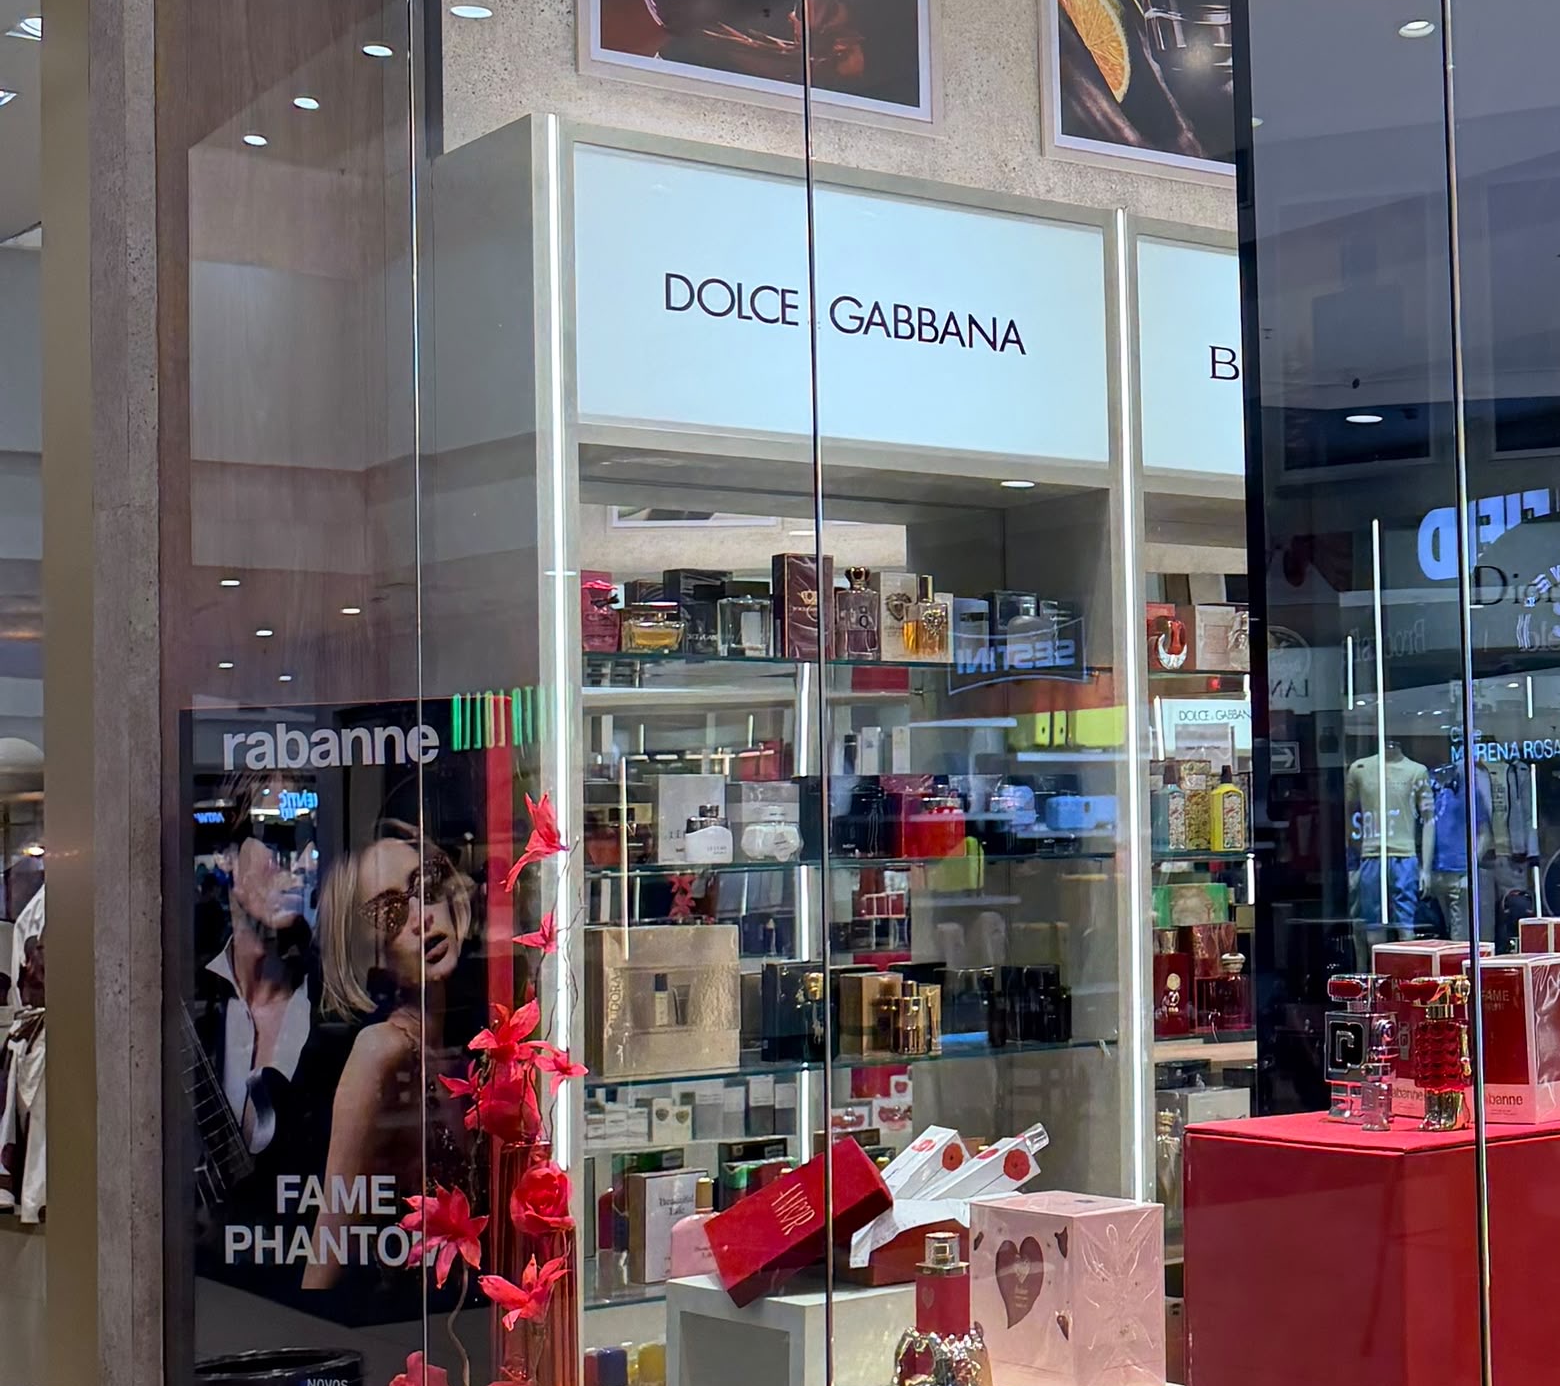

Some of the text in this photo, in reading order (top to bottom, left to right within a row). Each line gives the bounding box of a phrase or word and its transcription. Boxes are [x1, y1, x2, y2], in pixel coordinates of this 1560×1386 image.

[665, 273, 1027, 355] DOLCE GABBANA
[1179, 710, 1209, 721] DOLCE
[222, 723, 440, 772] rabanne
[276, 1174, 398, 1215] FAME
